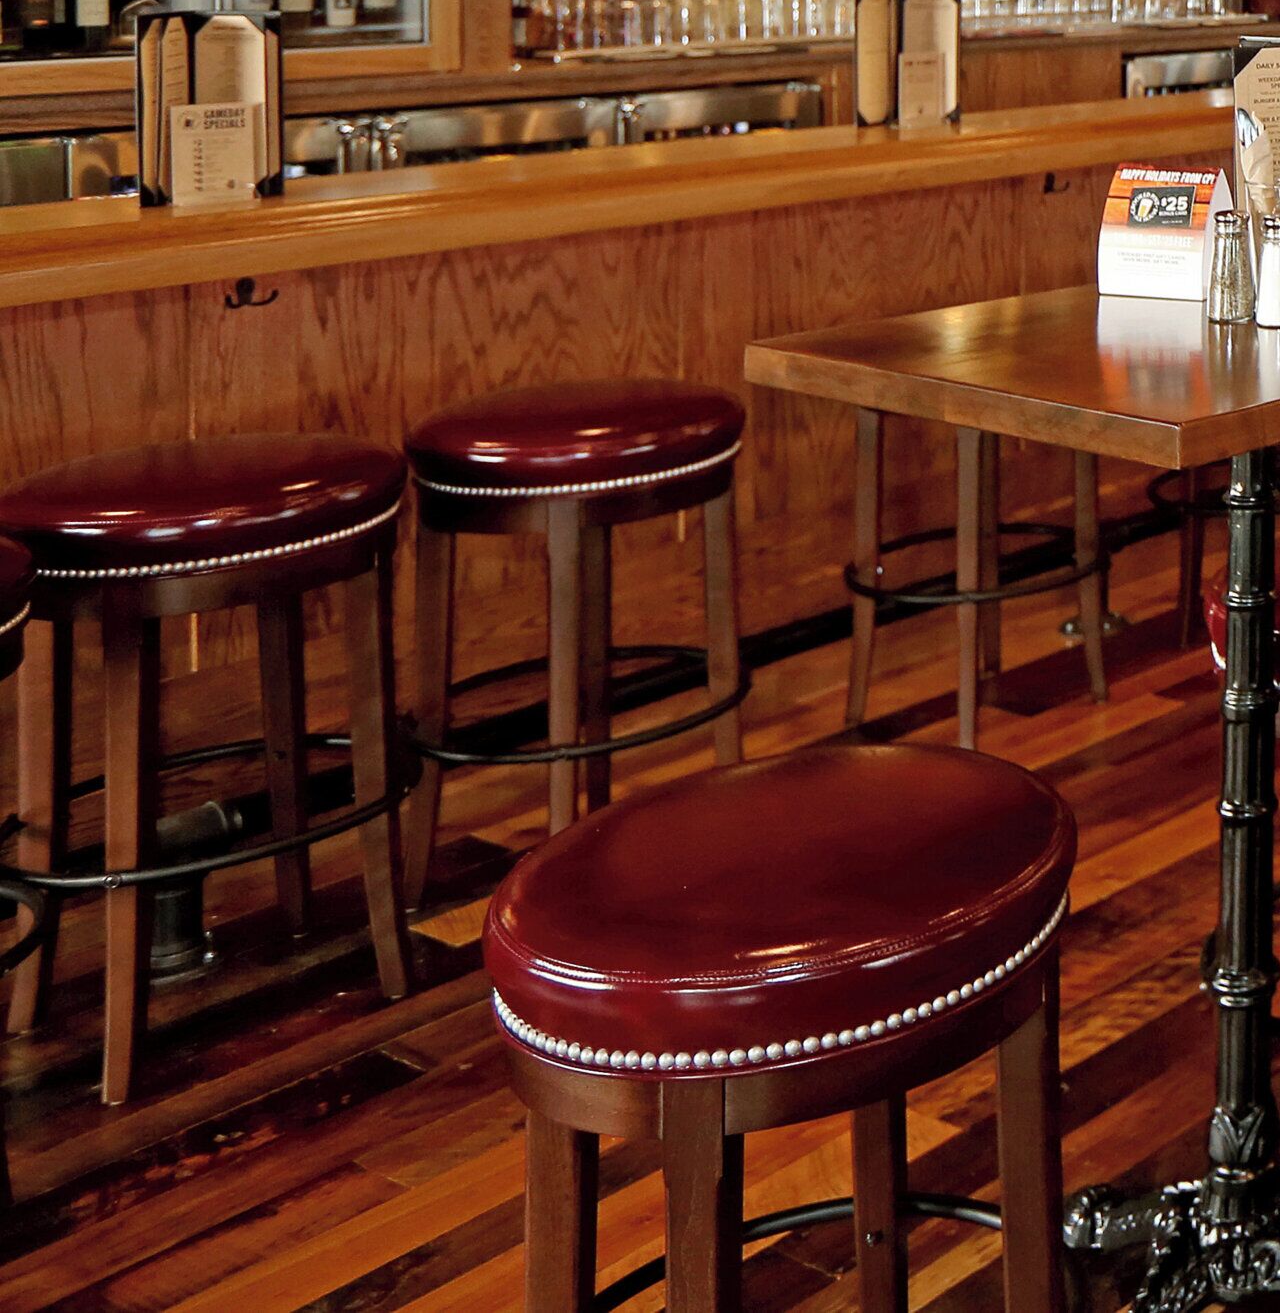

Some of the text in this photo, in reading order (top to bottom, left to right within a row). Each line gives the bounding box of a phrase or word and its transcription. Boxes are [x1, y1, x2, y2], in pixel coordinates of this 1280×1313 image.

[1120, 168, 1147, 180] HAPPY
[1145, 169, 1180, 182] HOLIDAYS
[1180, 172, 1201, 183] FROM
[1161, 196, 1188, 211] $25
